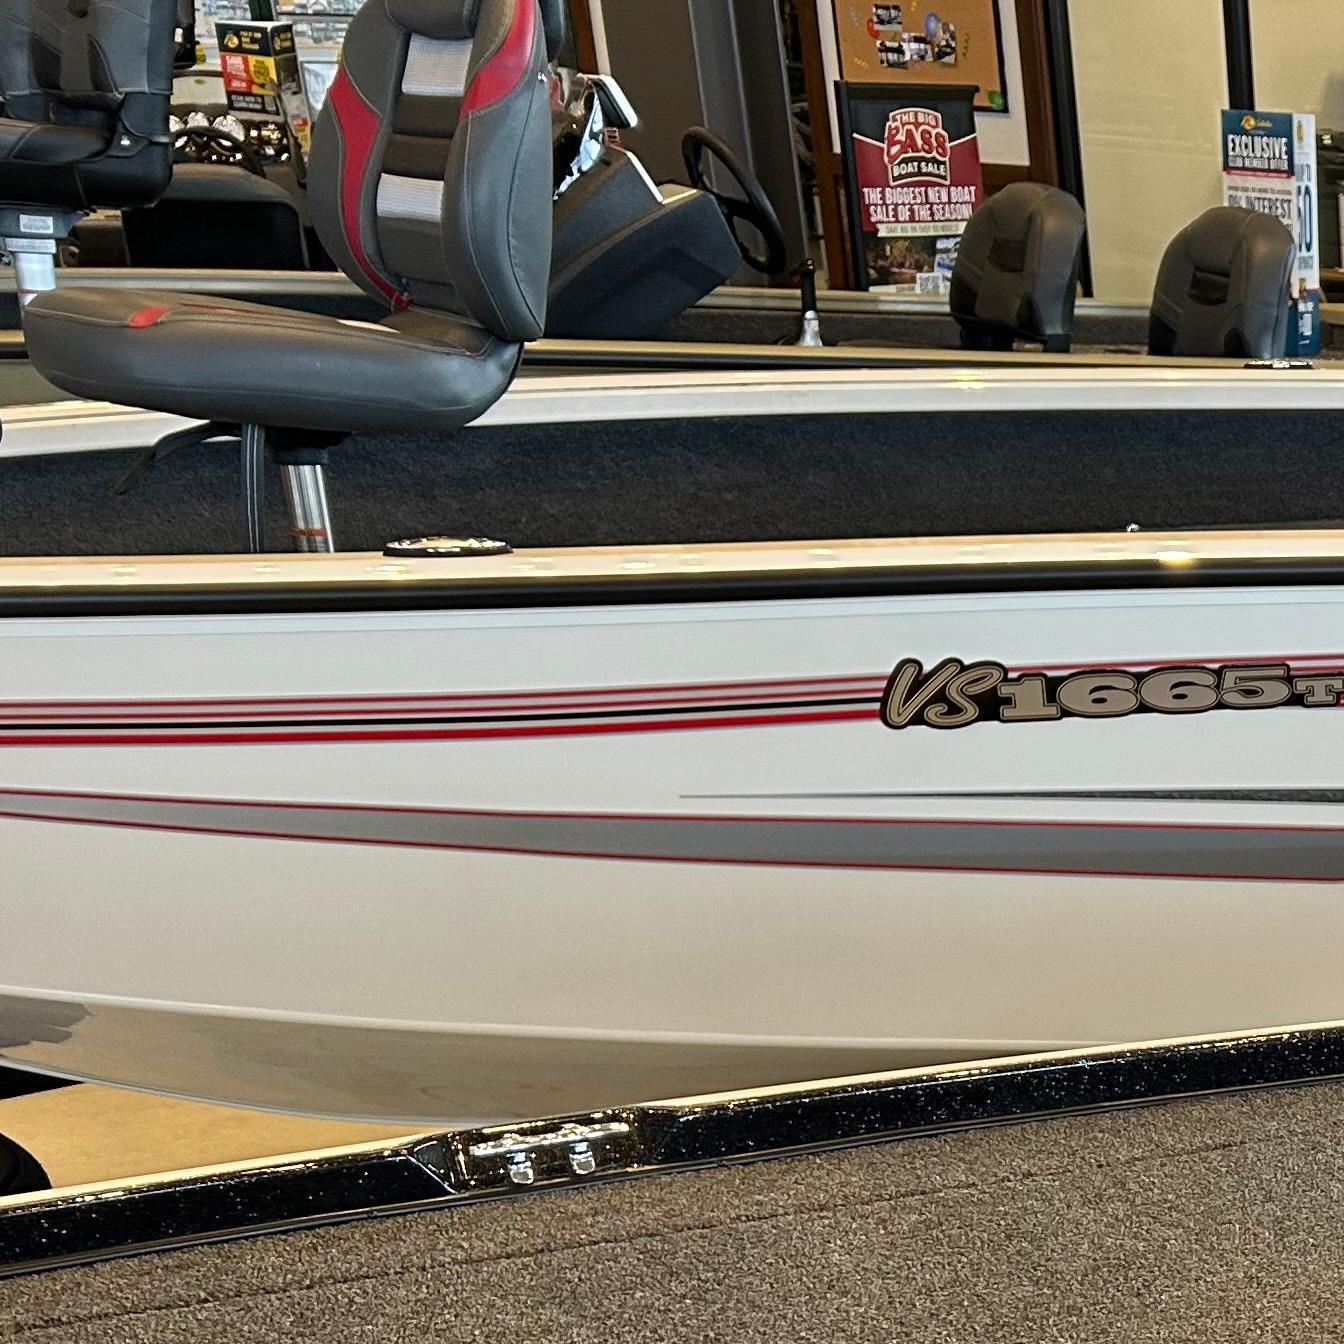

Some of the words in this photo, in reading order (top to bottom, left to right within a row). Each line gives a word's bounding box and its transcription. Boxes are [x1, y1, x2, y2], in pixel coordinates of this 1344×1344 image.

[895, 112, 915, 123] THE
[917, 112, 937, 126] BIG
[886, 126, 949, 164] BASS
[1227, 134, 1289, 160] EXCLUSIVE
[893, 161, 918, 177] BOAT
[920, 161, 946, 176] SALE
[863, 187, 883, 205] THE
[885, 187, 927, 205] BIGGEST
[927, 186, 949, 203] NEW
[950, 186, 976, 203] BOAT
[869, 205, 896, 222] SALE
[897, 205, 911, 222] OF
[913, 204, 933, 221] THE
